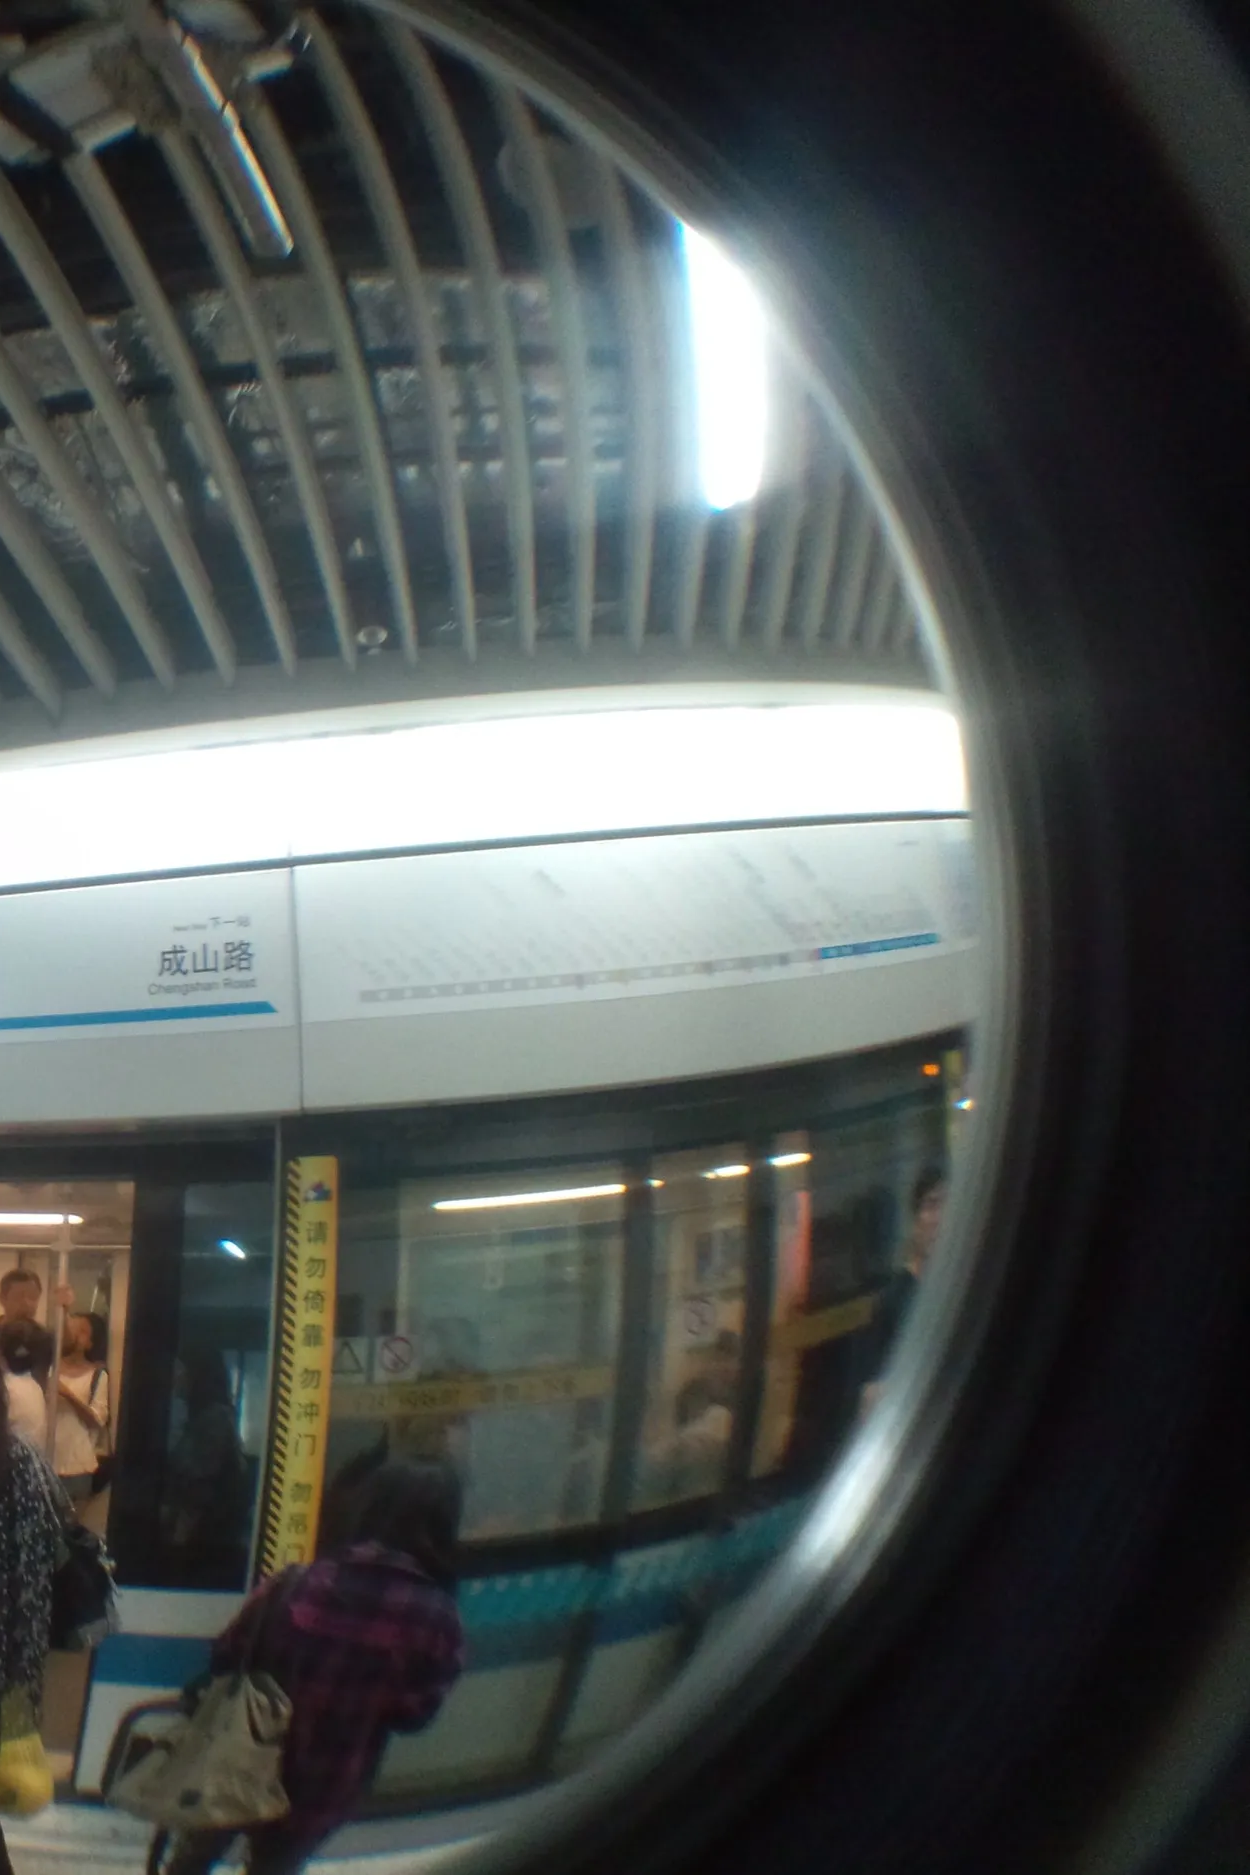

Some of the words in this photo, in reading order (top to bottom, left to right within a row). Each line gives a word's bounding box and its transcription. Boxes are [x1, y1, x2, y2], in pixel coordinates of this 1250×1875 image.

[158, 940, 255, 976] 成山路
[295, 1367, 322, 1457] 勿冲门
